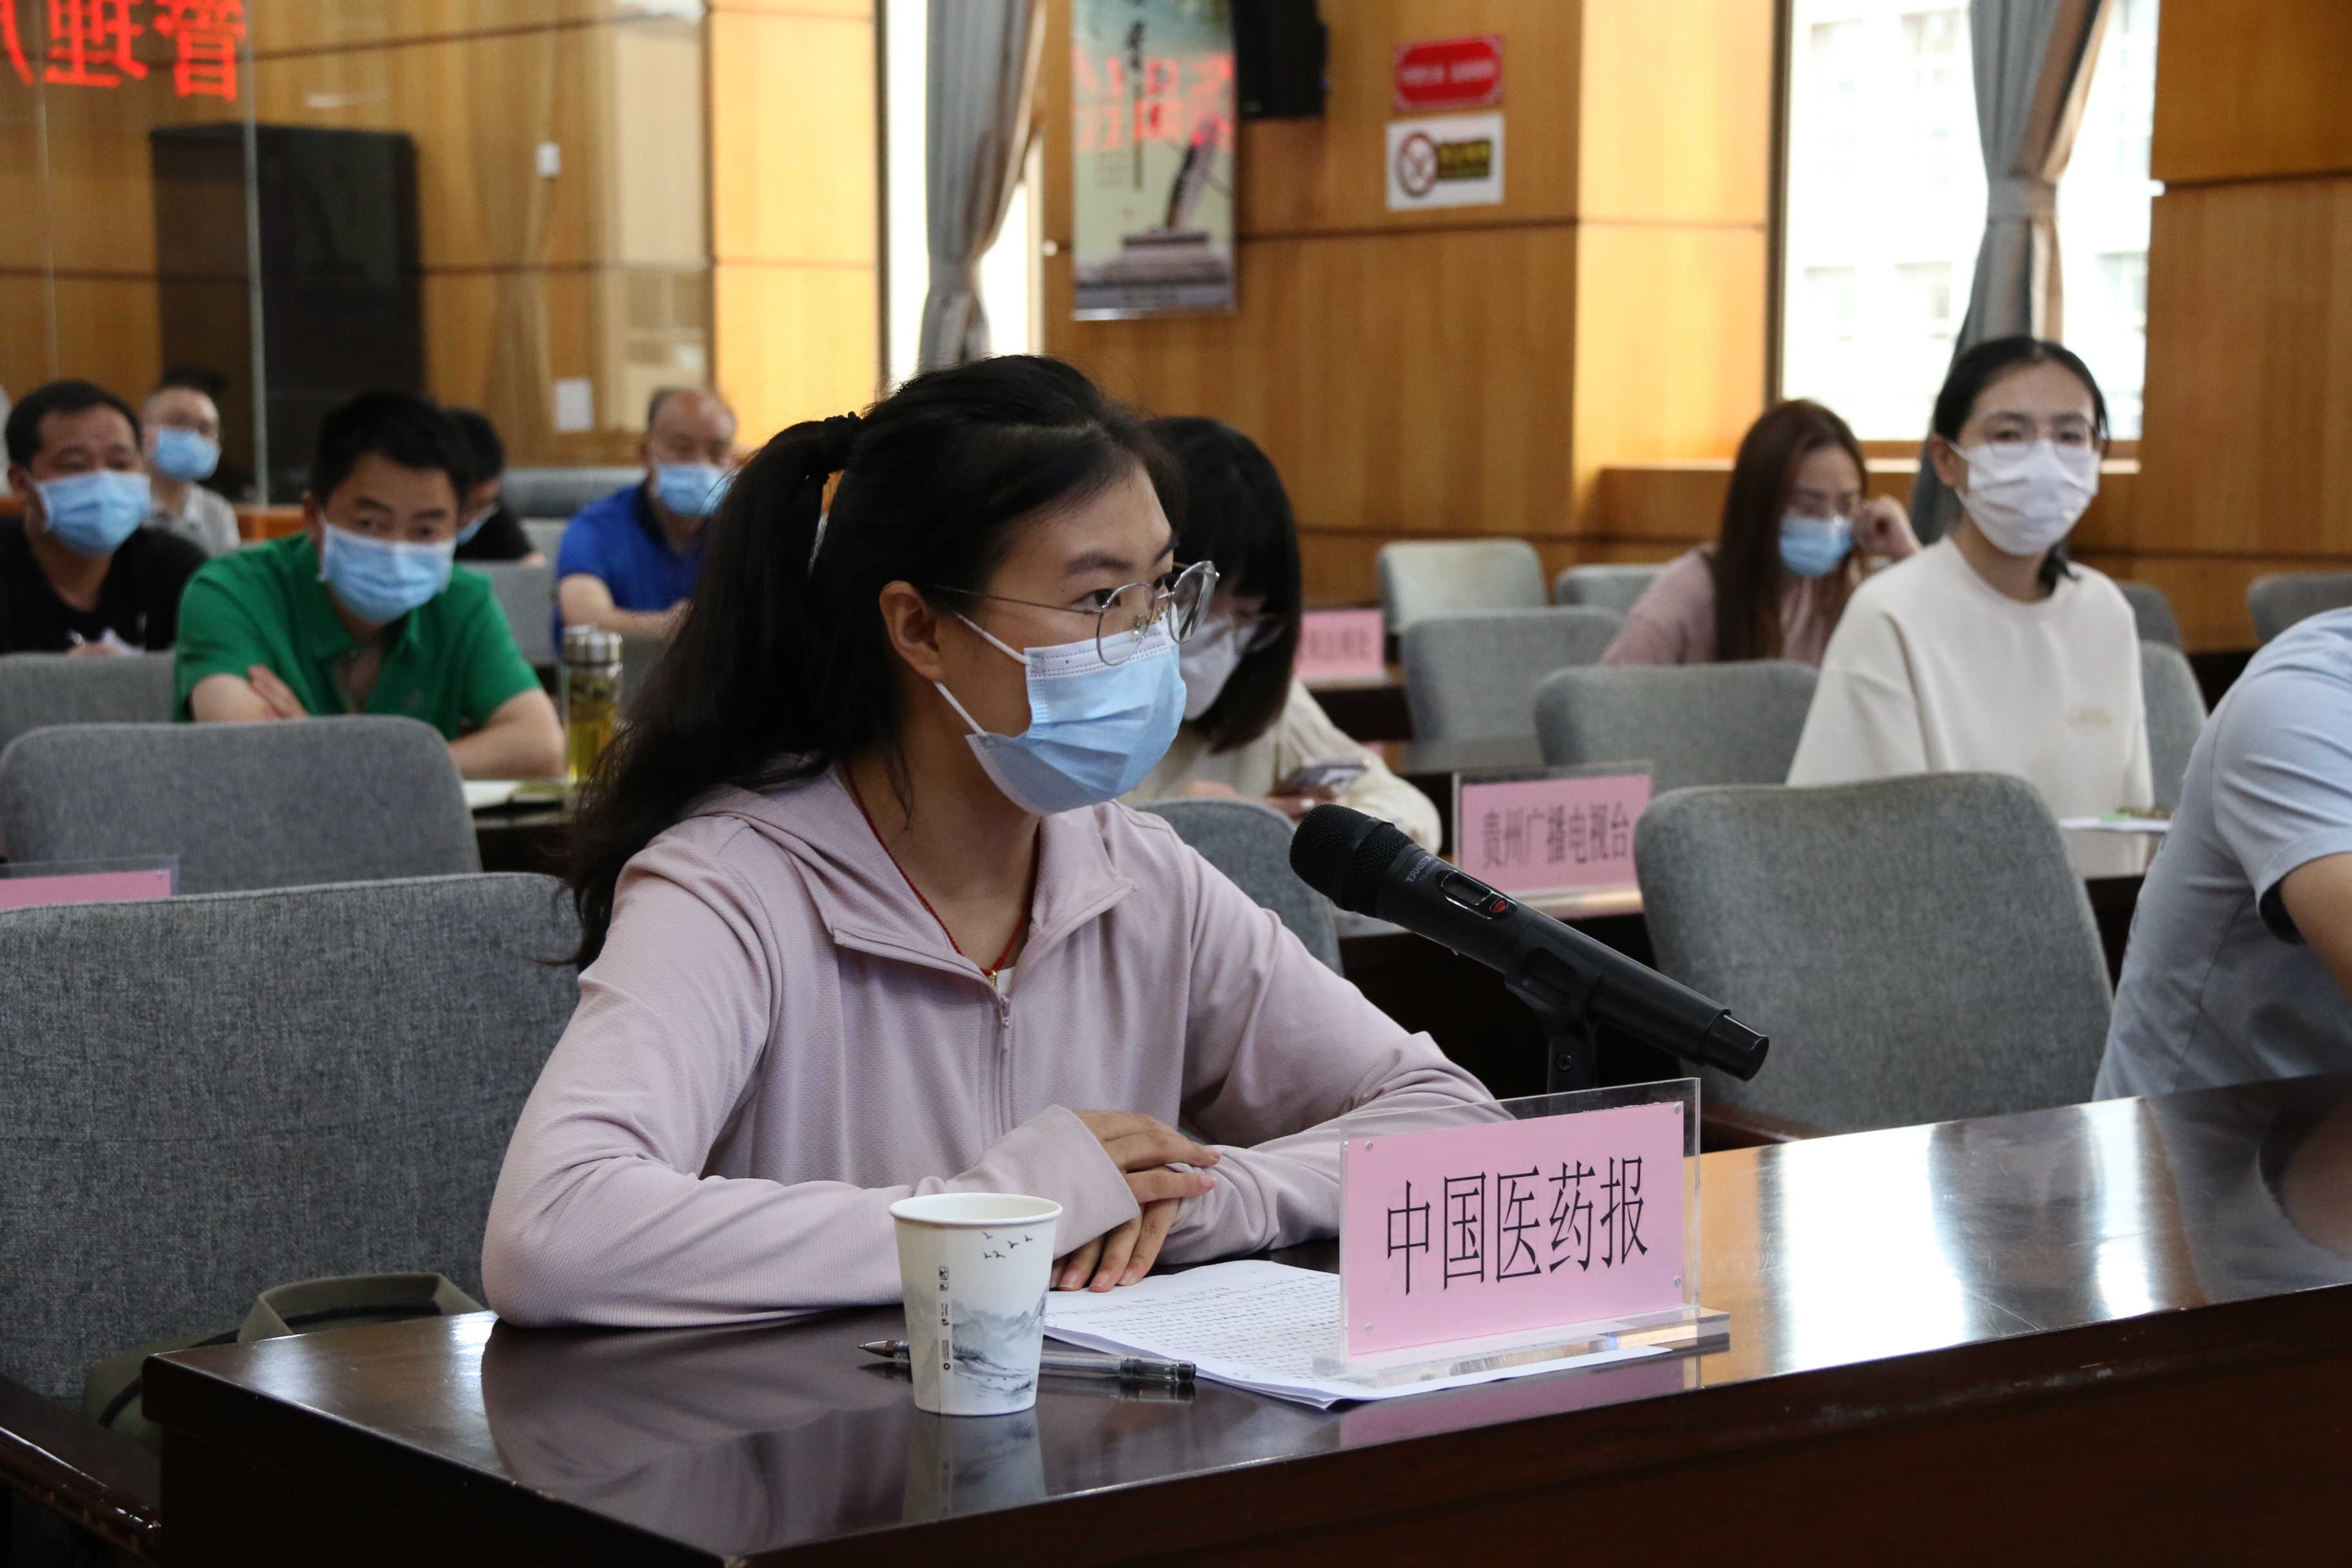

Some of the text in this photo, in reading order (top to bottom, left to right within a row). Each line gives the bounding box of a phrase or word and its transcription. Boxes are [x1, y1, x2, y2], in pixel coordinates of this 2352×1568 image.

[1482, 800, 1630, 870] 贵州广播电视台
[1386, 1155, 1649, 1296] 中国医药报
